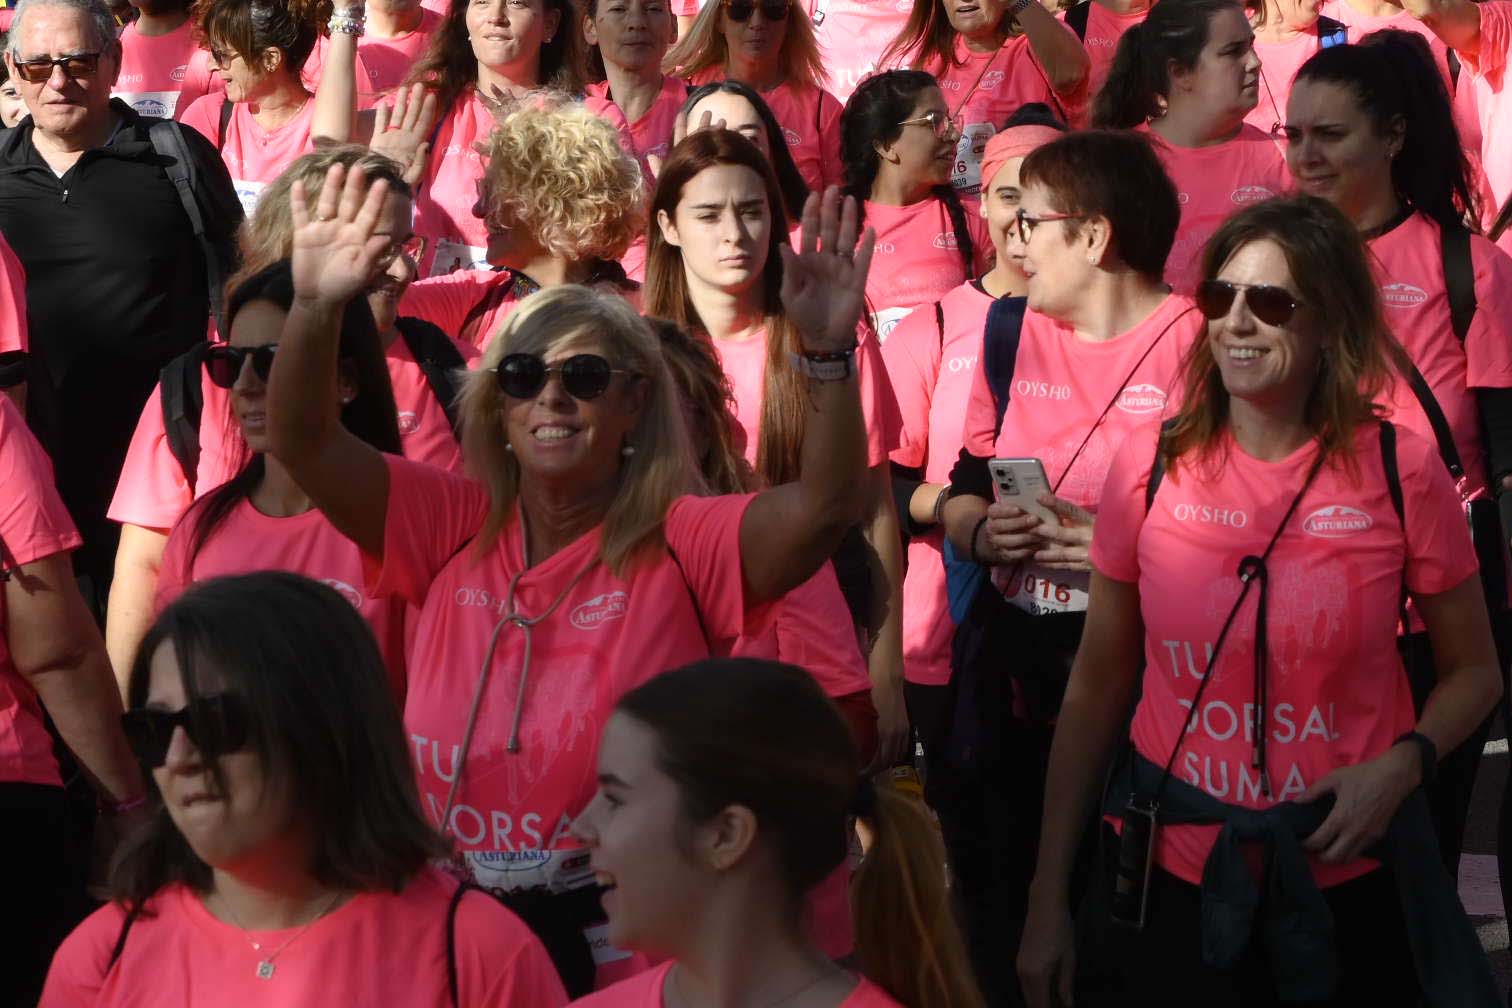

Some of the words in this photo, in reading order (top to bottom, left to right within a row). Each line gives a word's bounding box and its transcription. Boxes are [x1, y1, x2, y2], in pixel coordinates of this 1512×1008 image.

[1017, 378, 1071, 401] OYSHO
[1174, 503, 1249, 530] OYSHO
[1305, 517, 1371, 533] ASTURIANA
[1024, 574, 1072, 604] 016
[1162, 640, 1213, 681] TU
[412, 734, 461, 783] TU
[477, 849, 547, 862] ASTURIANA
